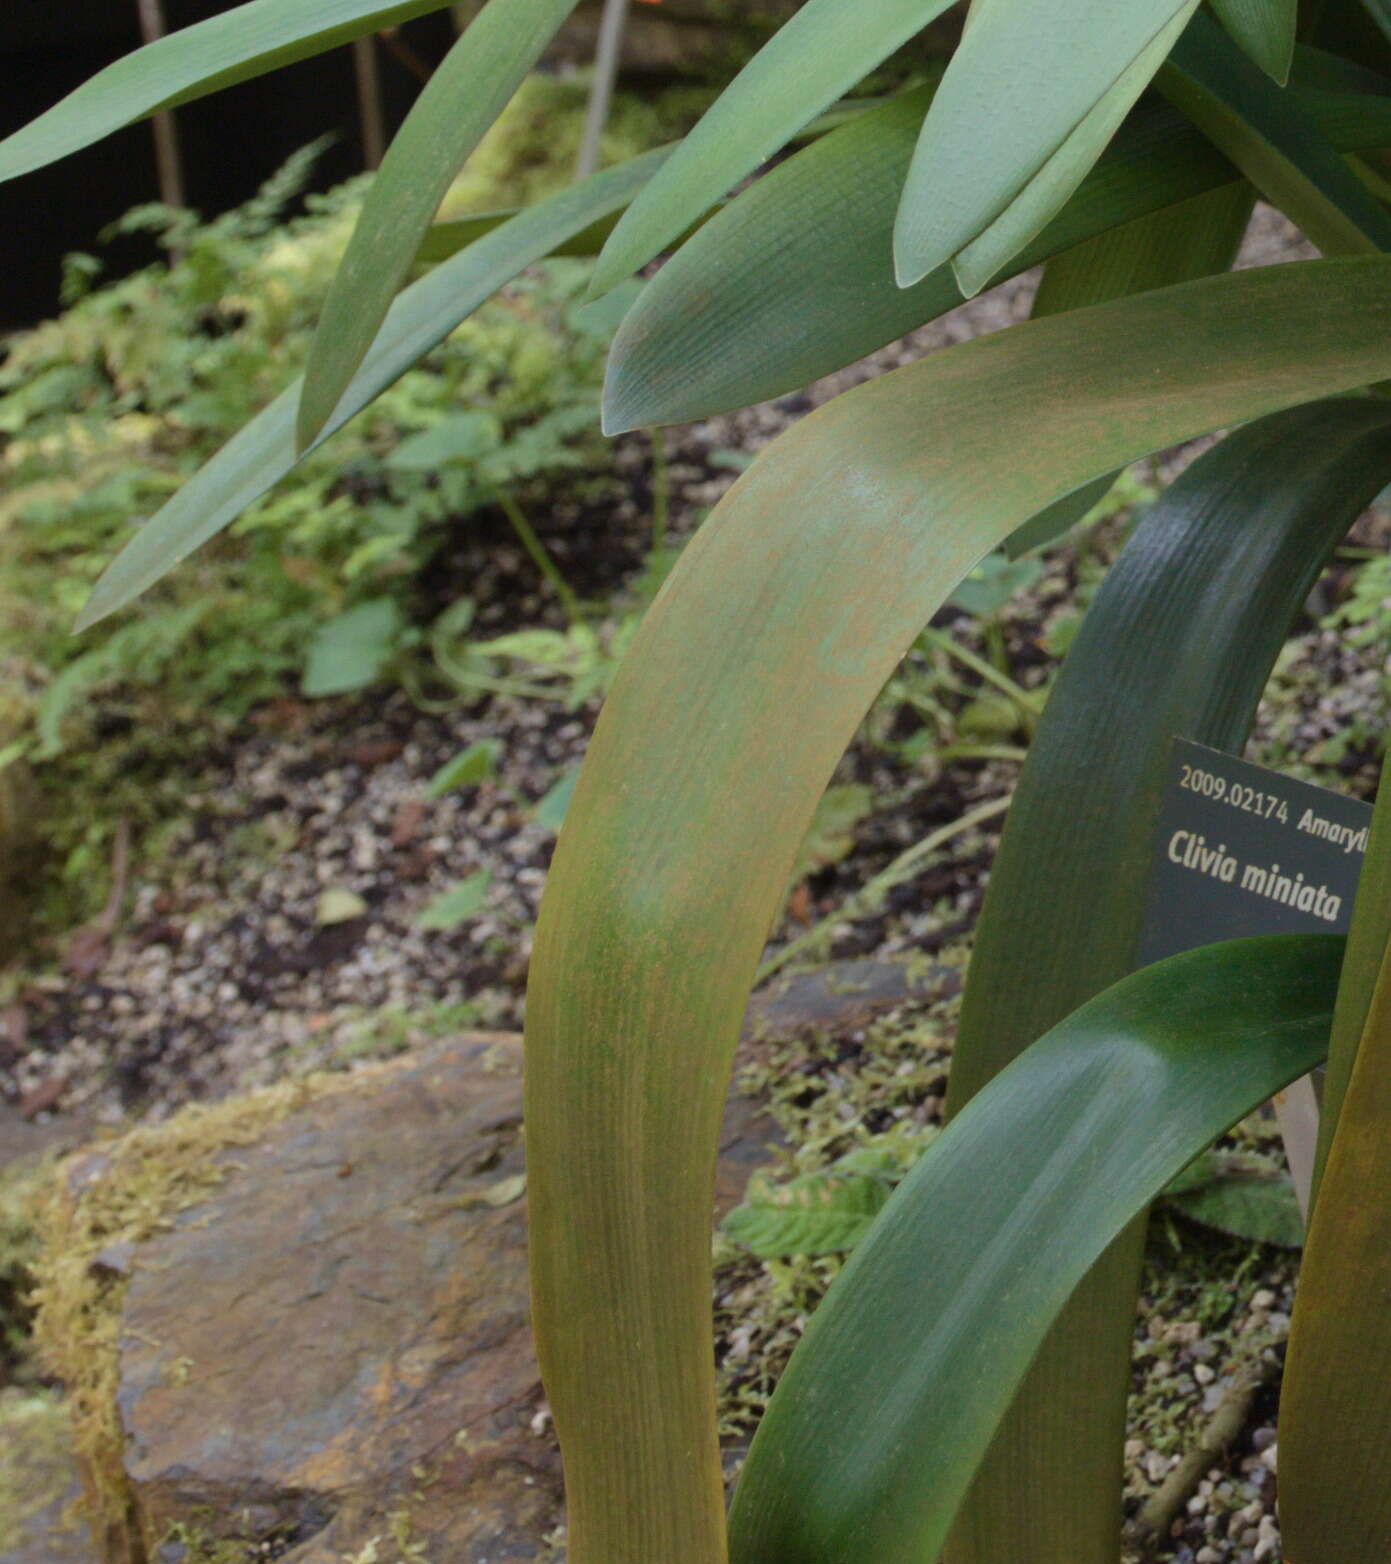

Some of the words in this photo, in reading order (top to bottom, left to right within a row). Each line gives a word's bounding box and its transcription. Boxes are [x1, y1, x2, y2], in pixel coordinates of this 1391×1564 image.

[1180, 765, 1288, 824] 2009.02174
[1168, 830, 1238, 882] Clivia
[1241, 864, 1342, 921] miniata
